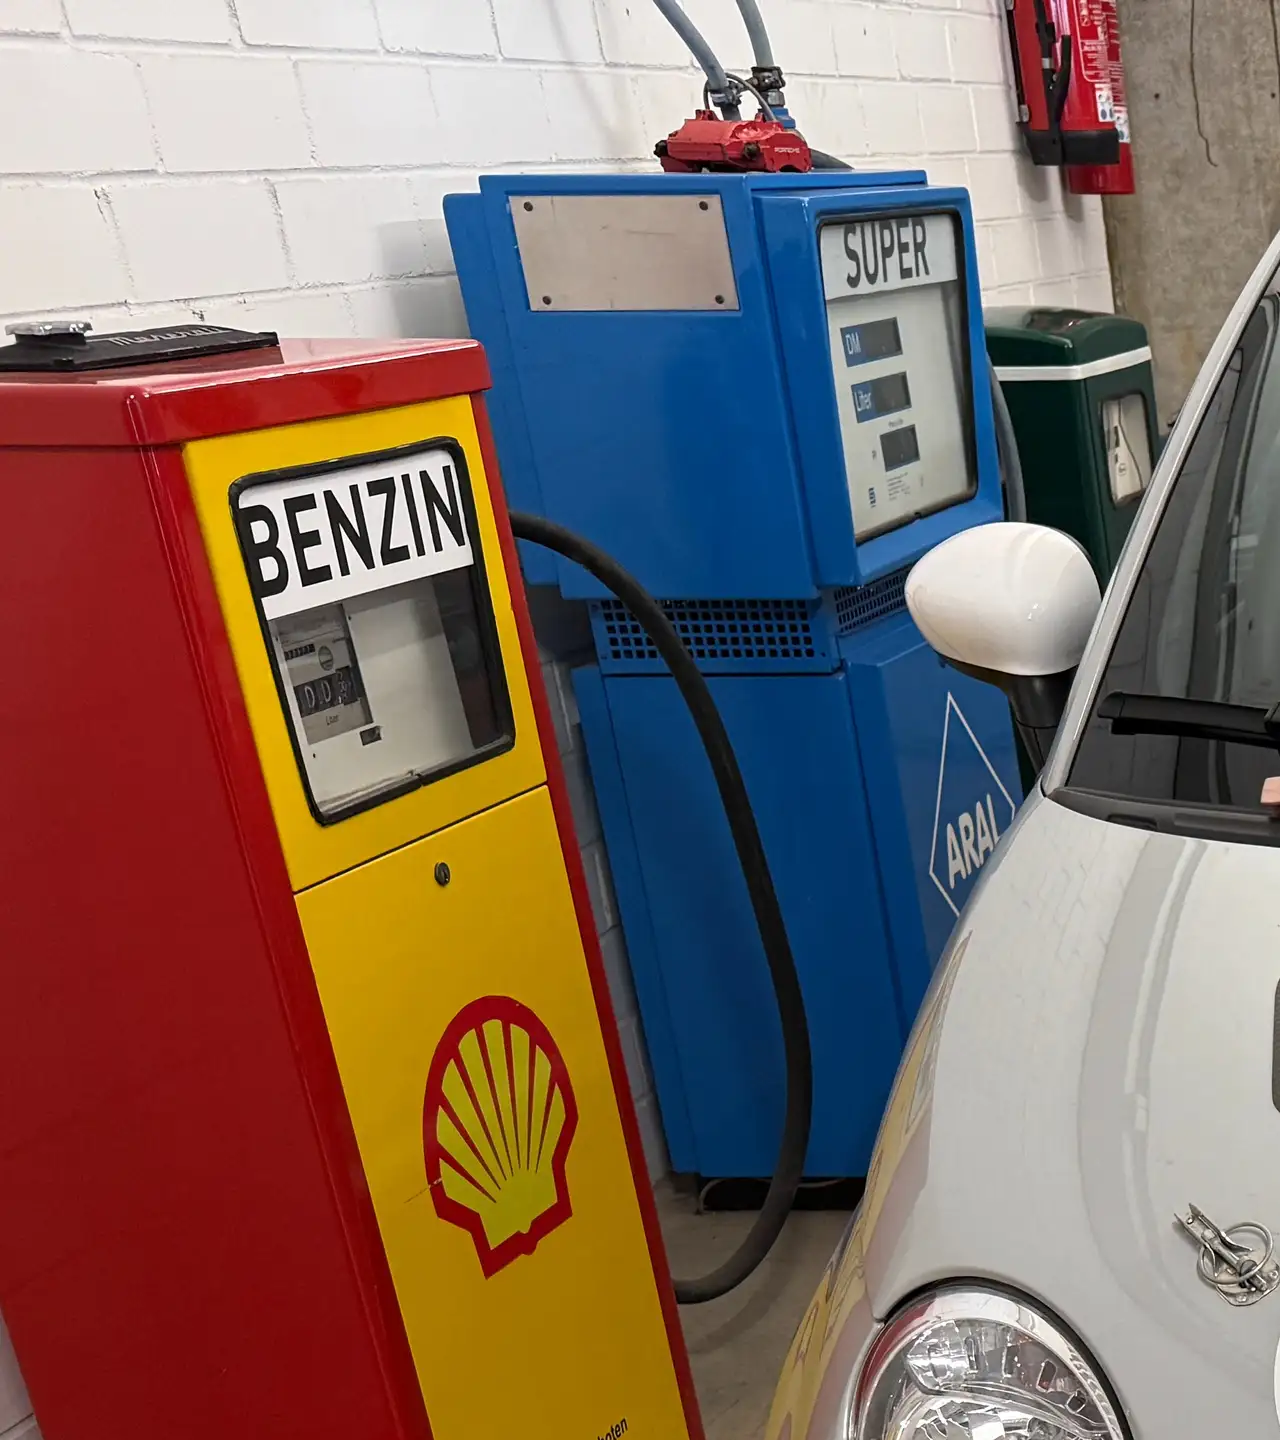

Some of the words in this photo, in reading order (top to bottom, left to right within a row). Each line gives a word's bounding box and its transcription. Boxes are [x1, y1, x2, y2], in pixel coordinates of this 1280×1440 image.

[843, 217, 930, 288] SUPER
[845, 332, 861, 355] DM
[854, 390, 872, 411] Liter
[238, 464, 466, 599] BENZIN
[946, 793, 1000, 889] ARAL
